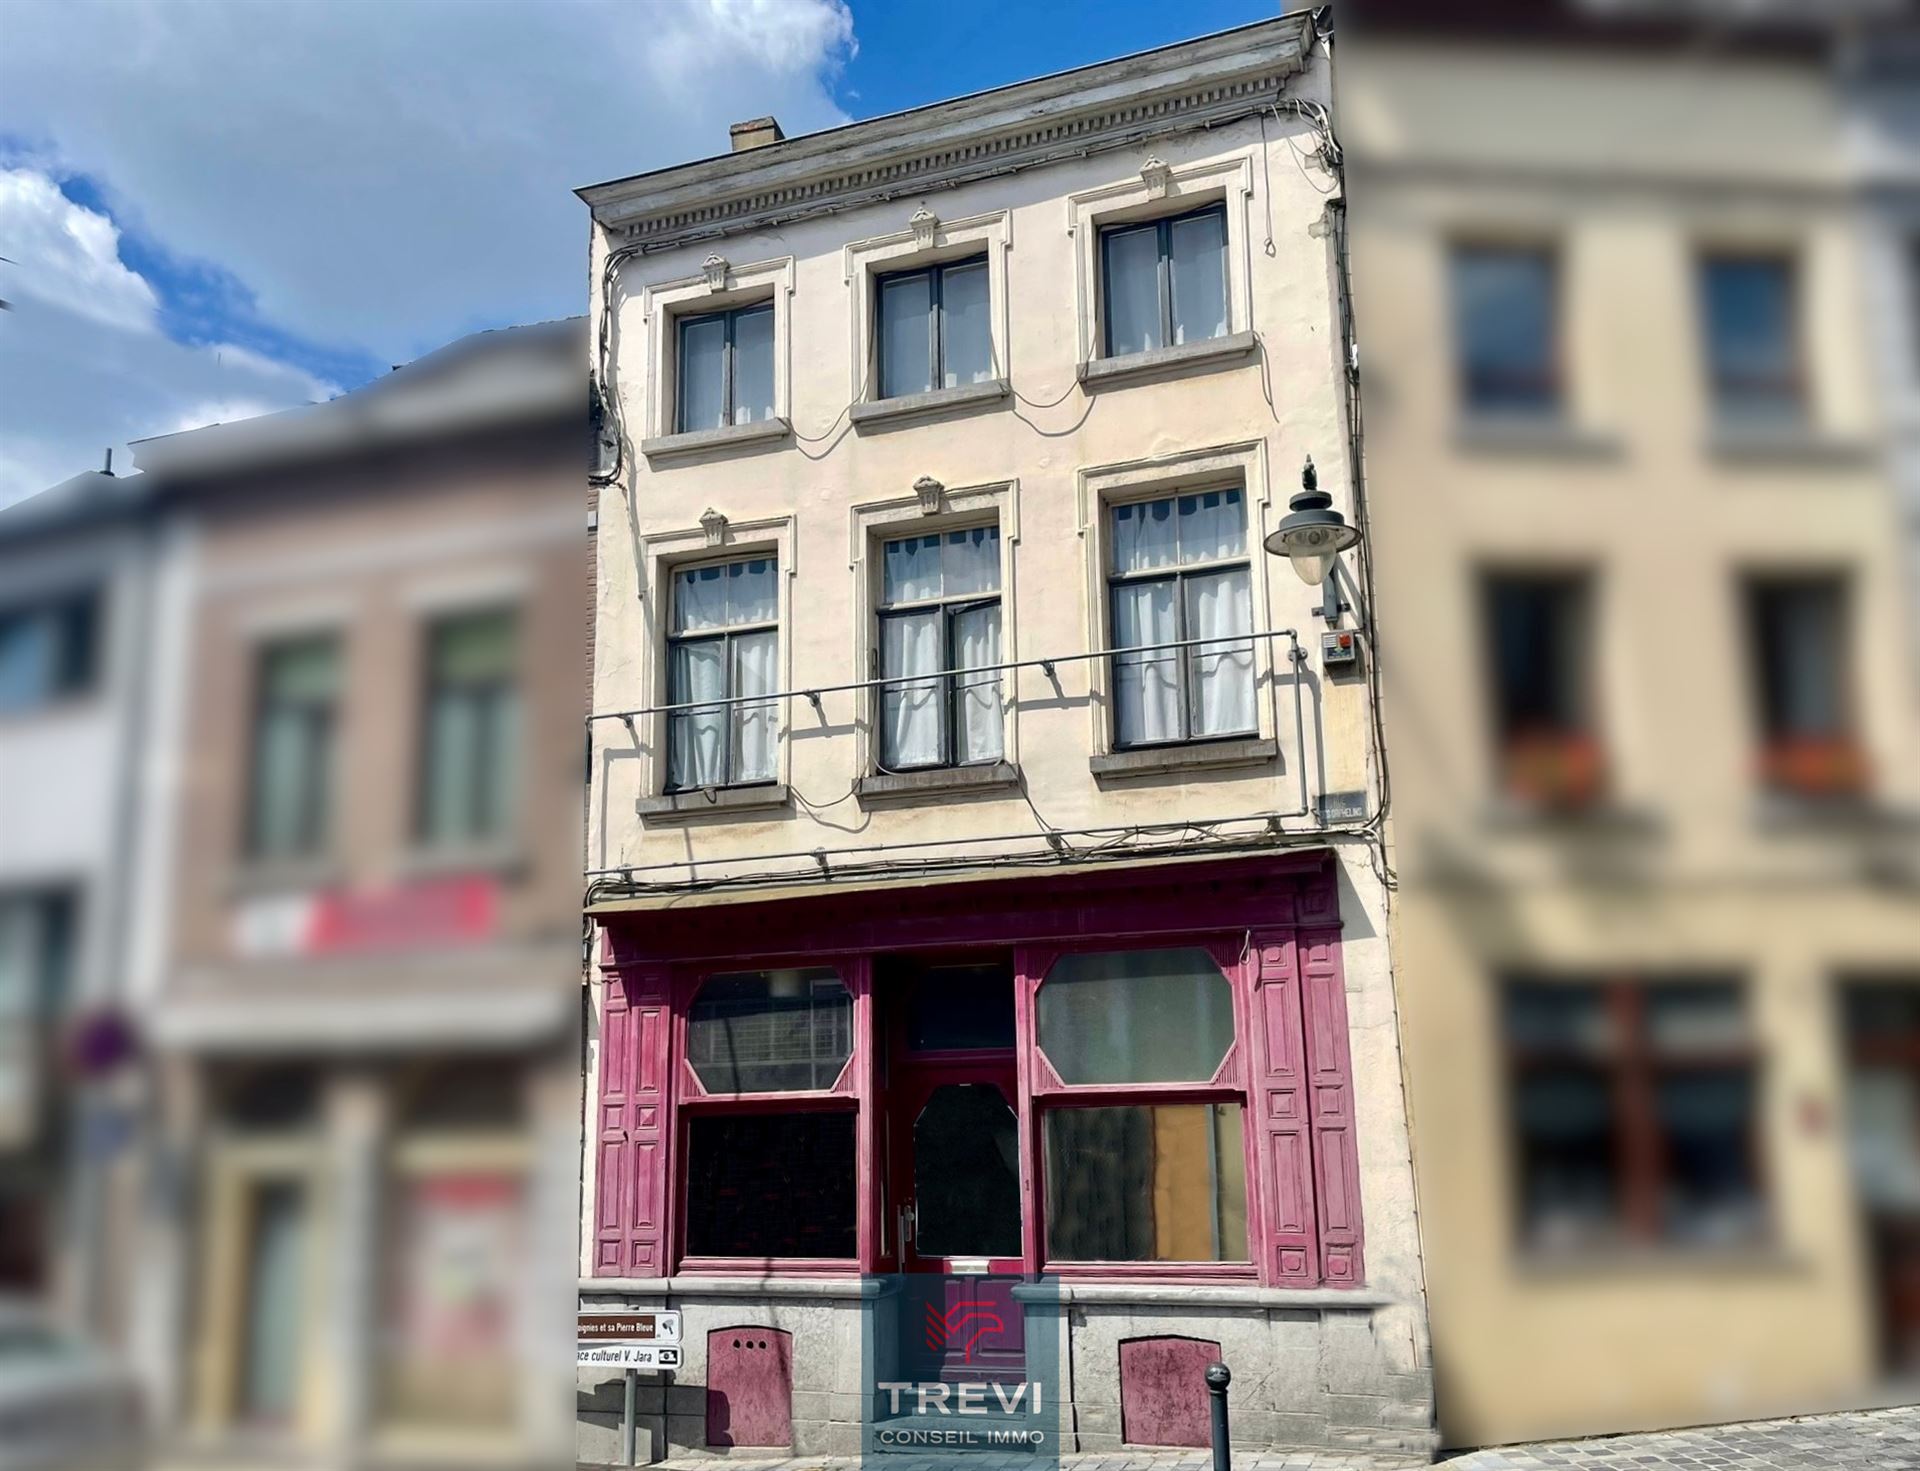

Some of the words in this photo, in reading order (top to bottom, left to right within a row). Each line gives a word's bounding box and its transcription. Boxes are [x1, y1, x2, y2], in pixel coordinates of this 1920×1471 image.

[600, 1323, 607, 1332] et
[607, 1324, 615, 1332] sa
[616, 1322, 635, 1332] Pierre
[636, 1322, 653, 1332] Bleue
[591, 1349, 622, 1362] culturel
[624, 1350, 631, 1362] V.
[633, 1350, 652, 1362] Jara
